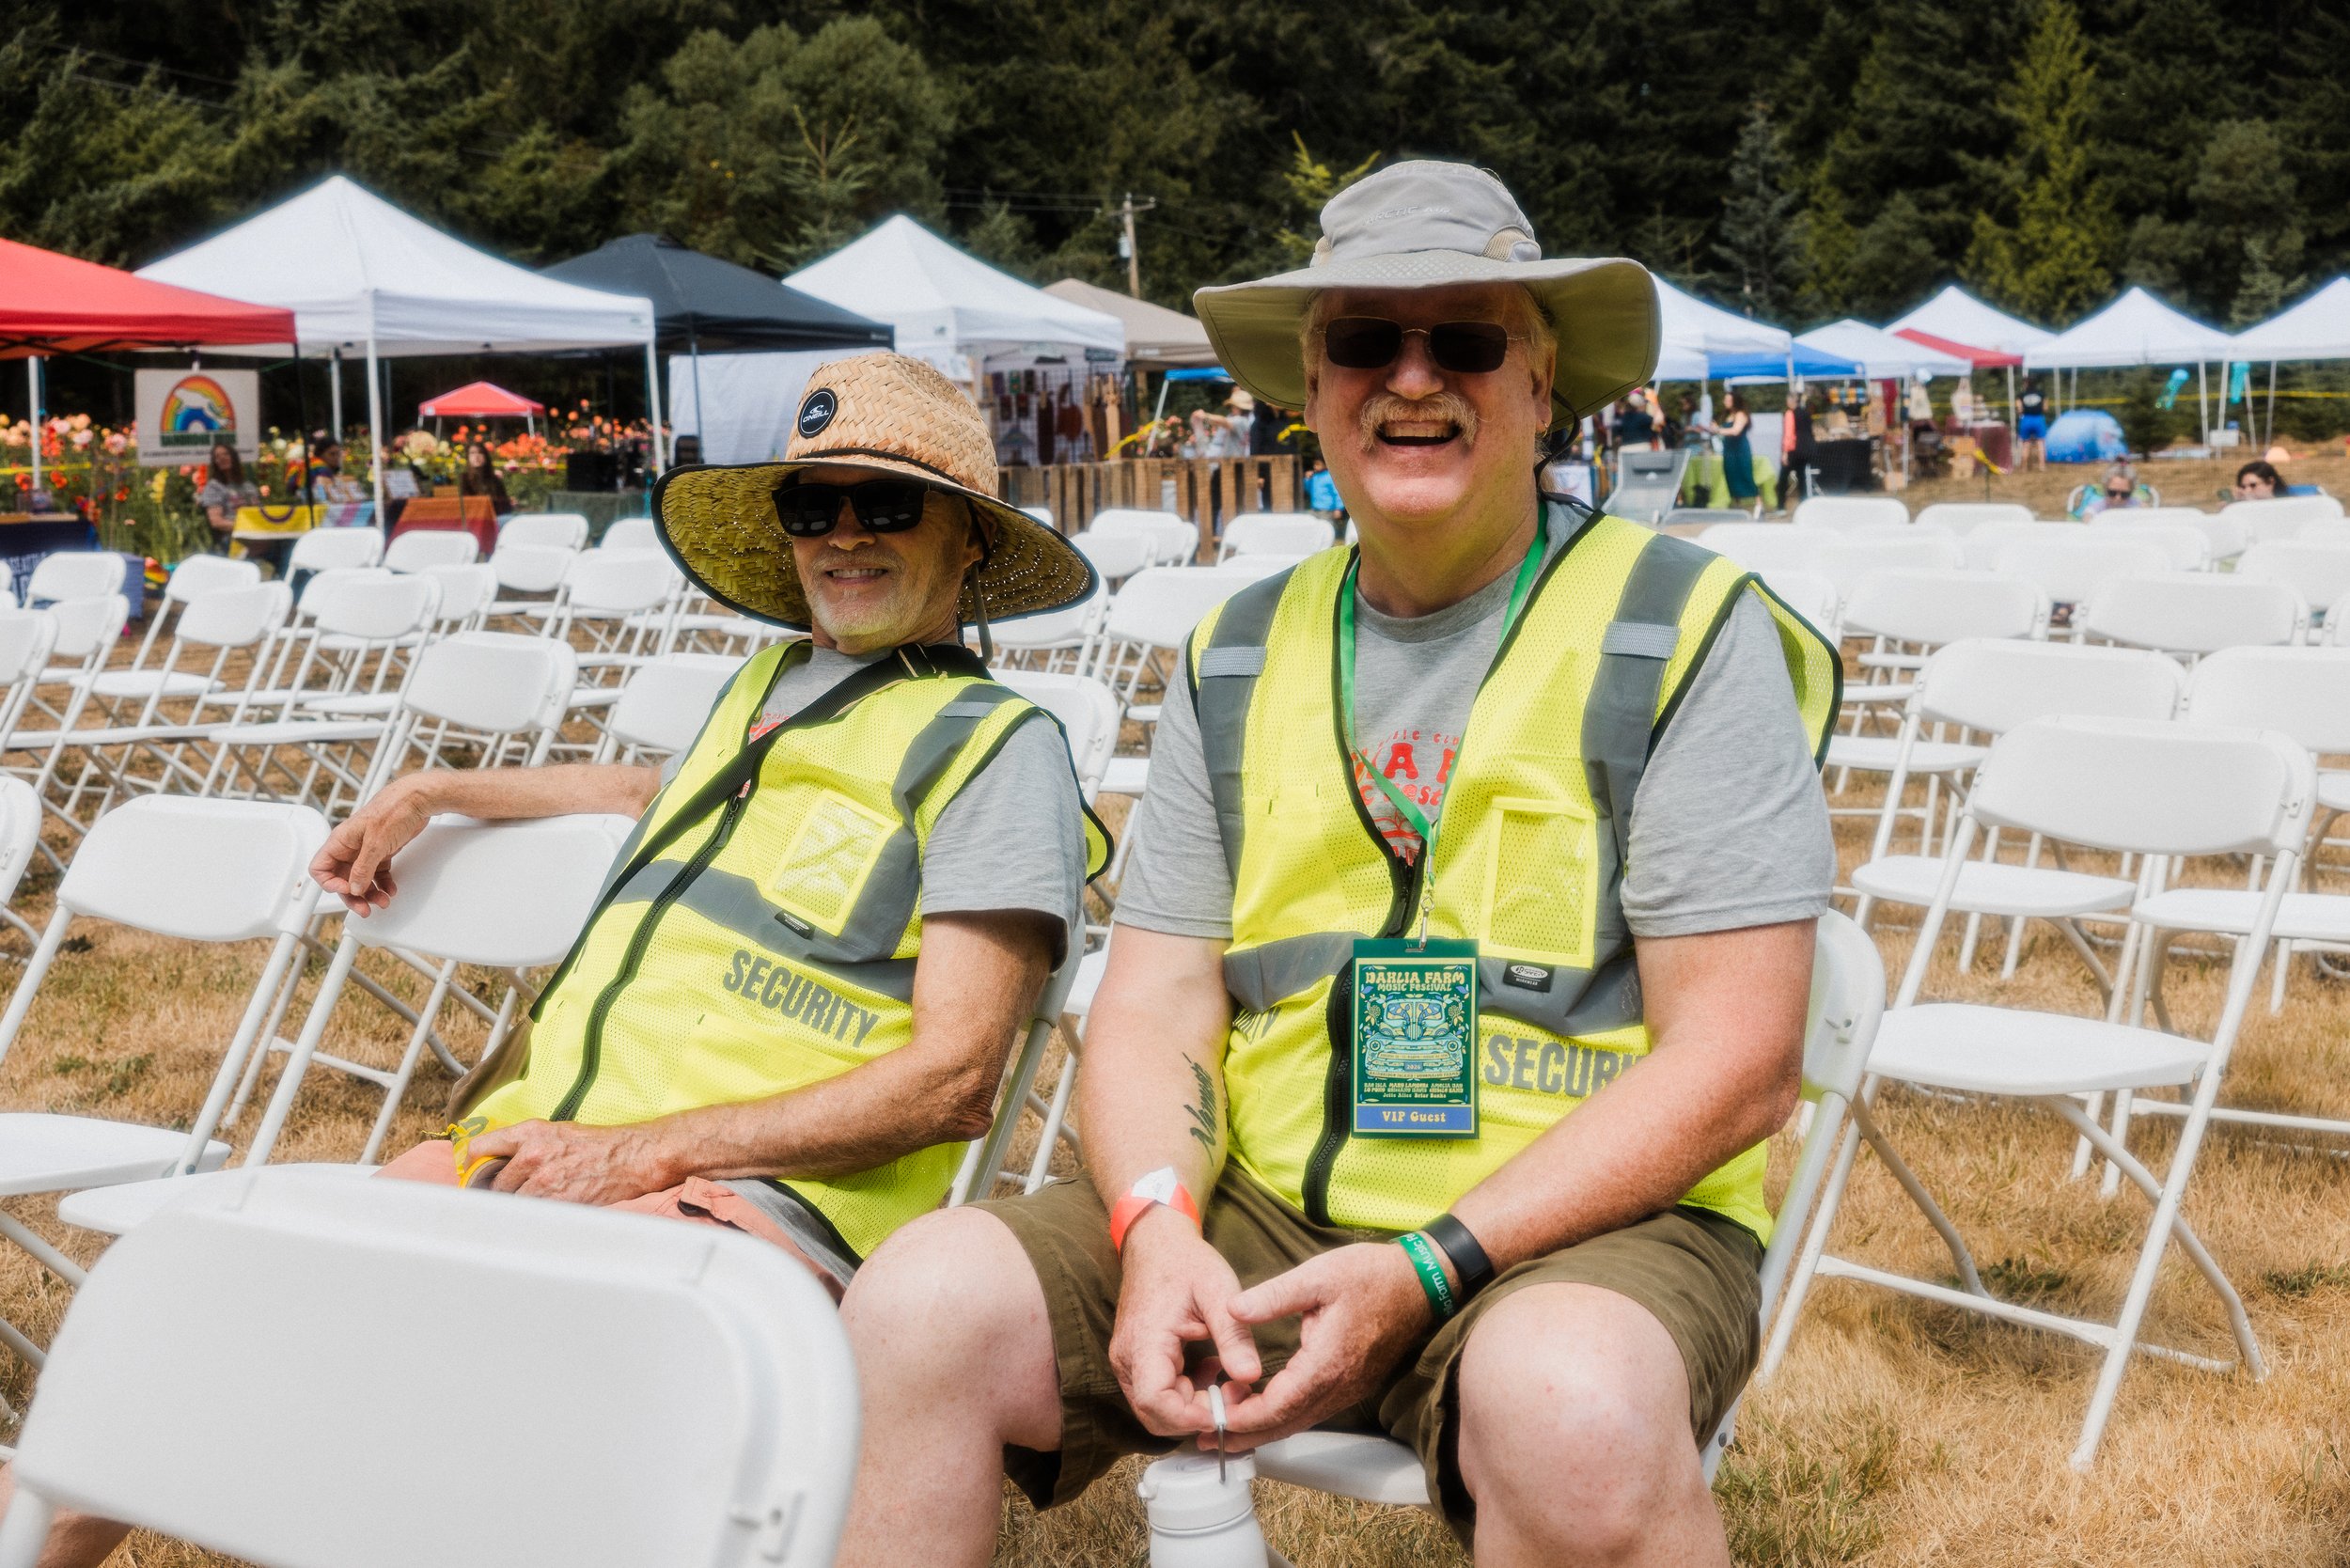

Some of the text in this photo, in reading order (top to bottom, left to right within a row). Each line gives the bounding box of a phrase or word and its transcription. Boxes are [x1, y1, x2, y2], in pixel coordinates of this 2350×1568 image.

[1366, 205, 1418, 226] ARCTIC
[1366, 972, 1465, 985] DAHLIA FARM
[1377, 983, 1407, 992] MUSIC
[723, 949, 881, 1048] SECURITY
[1485, 1035, 1646, 1098] SECUR
[1382, 1111, 1446, 1122] VIP Guest
[1413, 1240, 1437, 1272] Music
[1432, 1272, 1449, 1301] Farm
